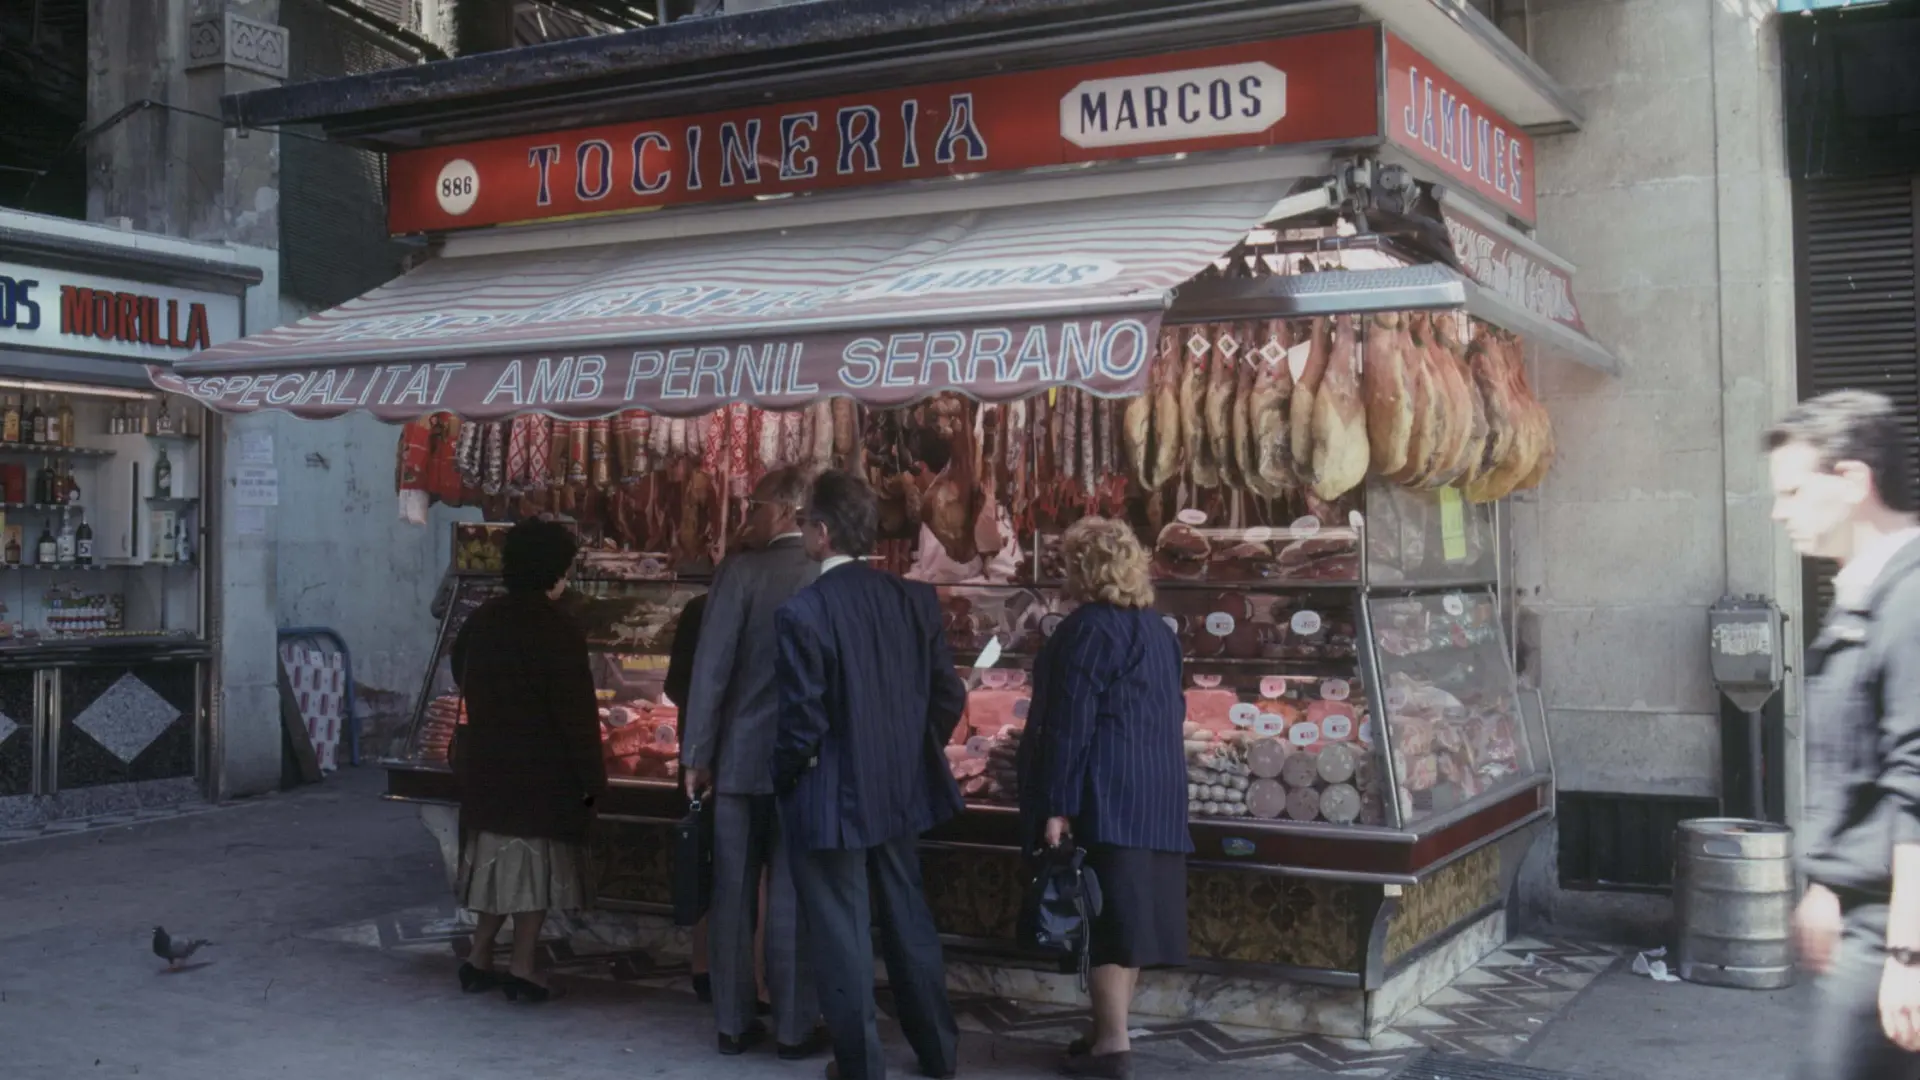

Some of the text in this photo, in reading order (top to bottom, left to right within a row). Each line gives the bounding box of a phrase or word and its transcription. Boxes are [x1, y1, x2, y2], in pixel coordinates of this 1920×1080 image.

[441, 74, 1263, 206] 886 TOCINERIA MARCOS
[1404, 66, 1523, 204] JAMONES
[60, 284, 211, 351] MORILLA
[483, 354, 607, 405] AMB
[623, 342, 820, 400] PERNIL
[838, 318, 1148, 388] SERRANO
